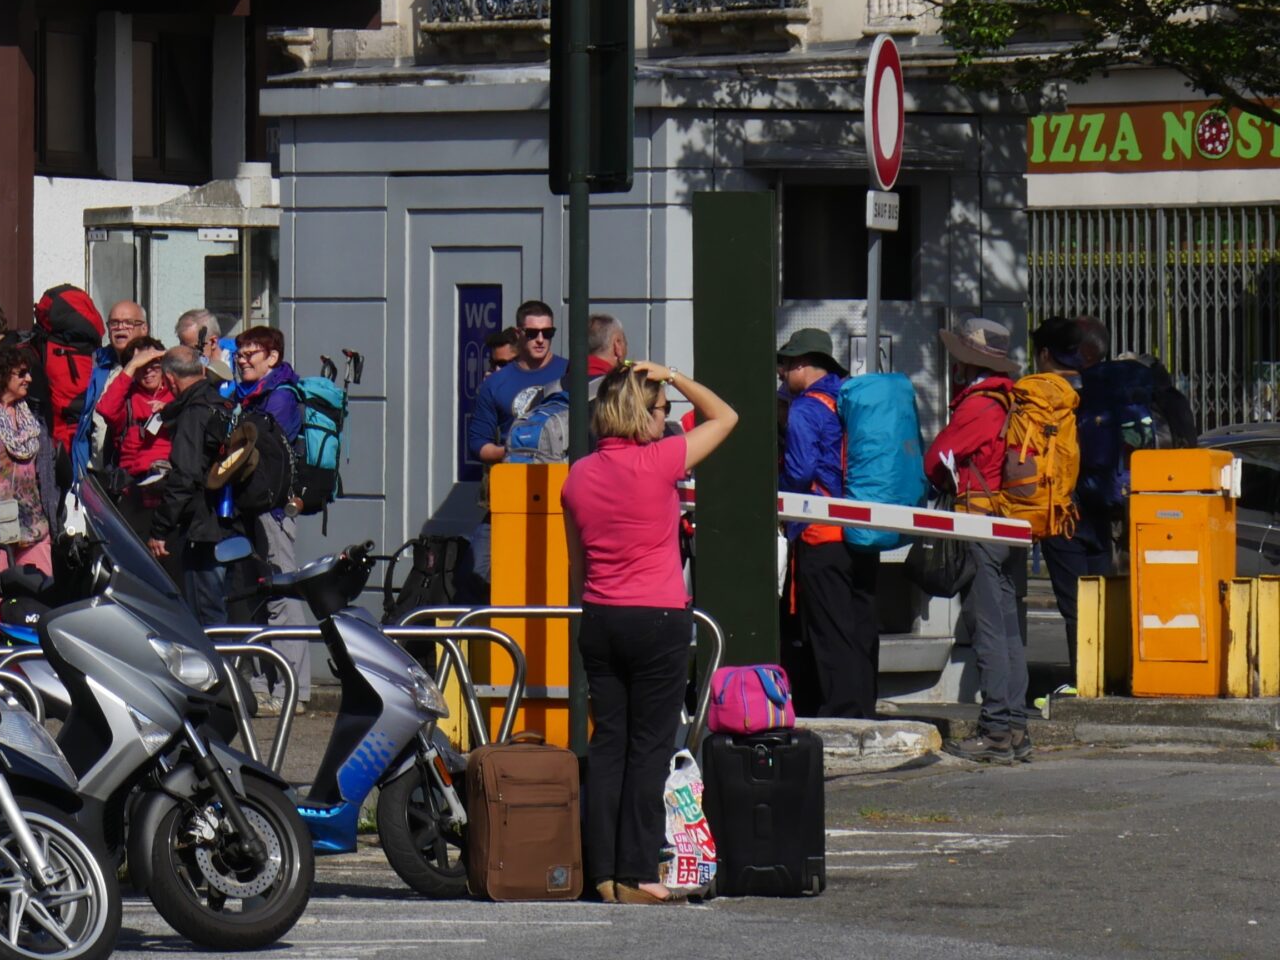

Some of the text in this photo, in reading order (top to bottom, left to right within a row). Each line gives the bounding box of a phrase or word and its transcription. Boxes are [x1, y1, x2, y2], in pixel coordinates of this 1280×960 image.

[874, 202, 898, 220] SAUF BUS
[465, 302, 497, 329] WC
